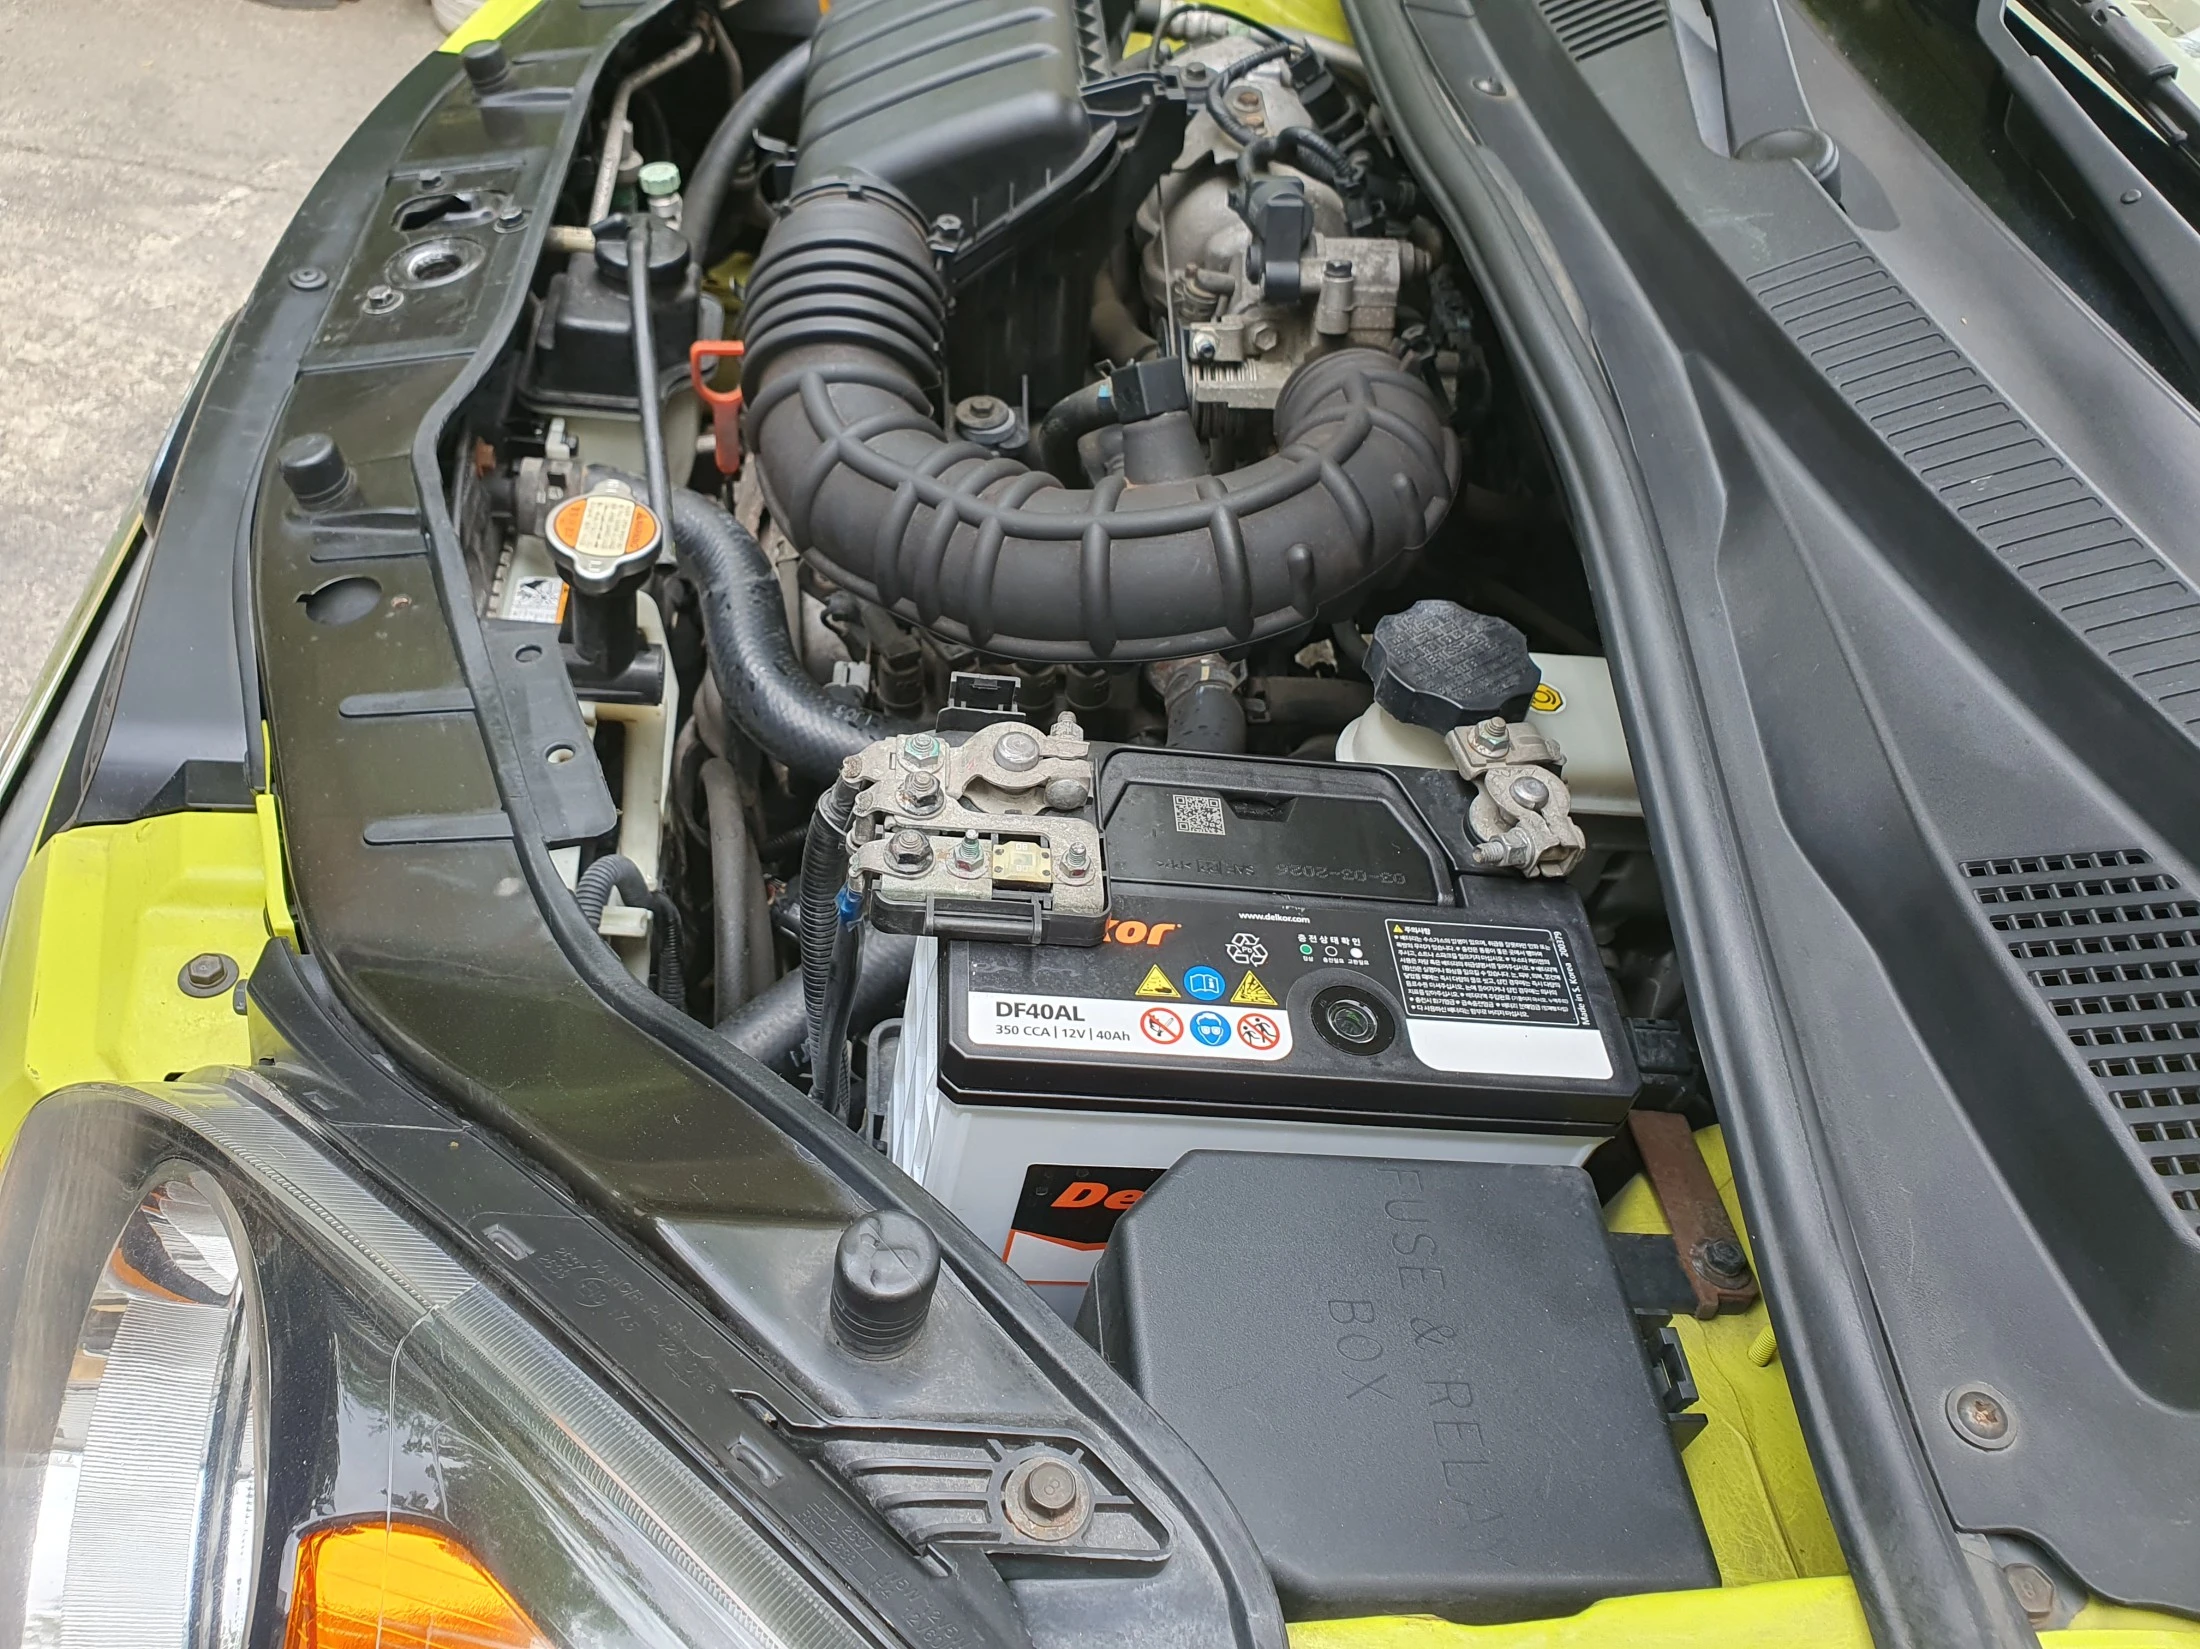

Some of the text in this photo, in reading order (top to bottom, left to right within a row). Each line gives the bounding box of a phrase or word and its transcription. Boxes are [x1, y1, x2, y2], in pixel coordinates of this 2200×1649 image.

[1238, 912, 1311, 924] www.delkor.com
[1565, 962, 1578, 984] Korea
[995, 1001, 1085, 1022] DF40AL
[1577, 1003, 1590, 1026] Made
[996, 1024, 1131, 1042] 350 CCA 12V 40Ah
[1377, 1167, 1446, 1290] FUSE
[1328, 1300, 1397, 1401] BOX
